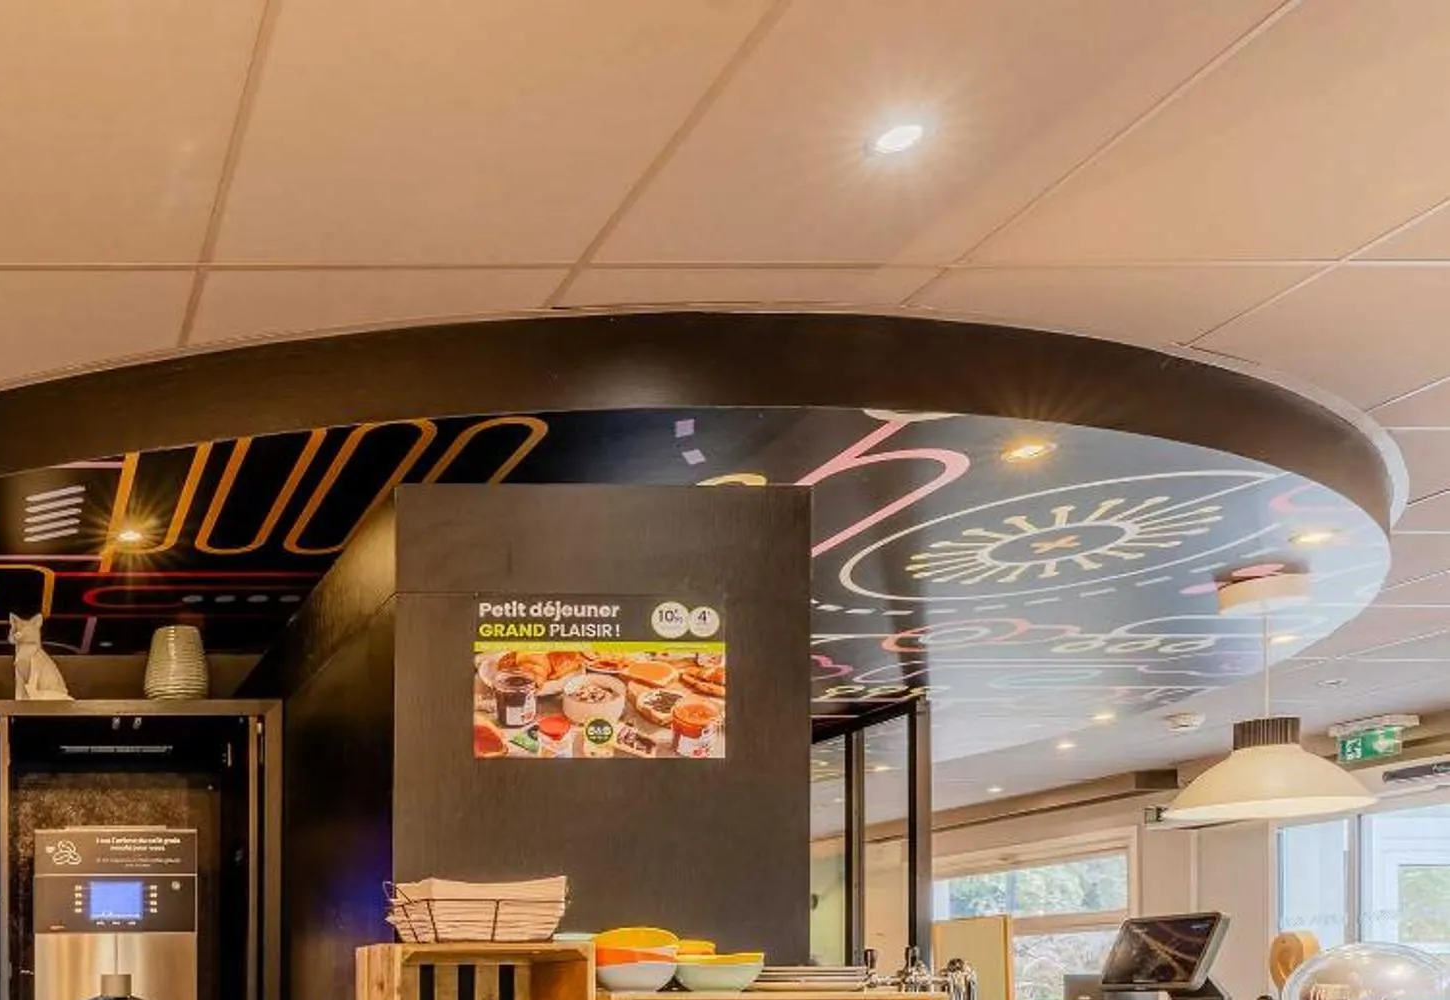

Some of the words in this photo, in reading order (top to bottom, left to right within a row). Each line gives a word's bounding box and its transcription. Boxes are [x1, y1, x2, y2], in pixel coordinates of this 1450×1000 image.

[479, 601, 526, 617] Petit
[530, 601, 620, 621] déjeuner
[479, 624, 546, 637] GRAND
